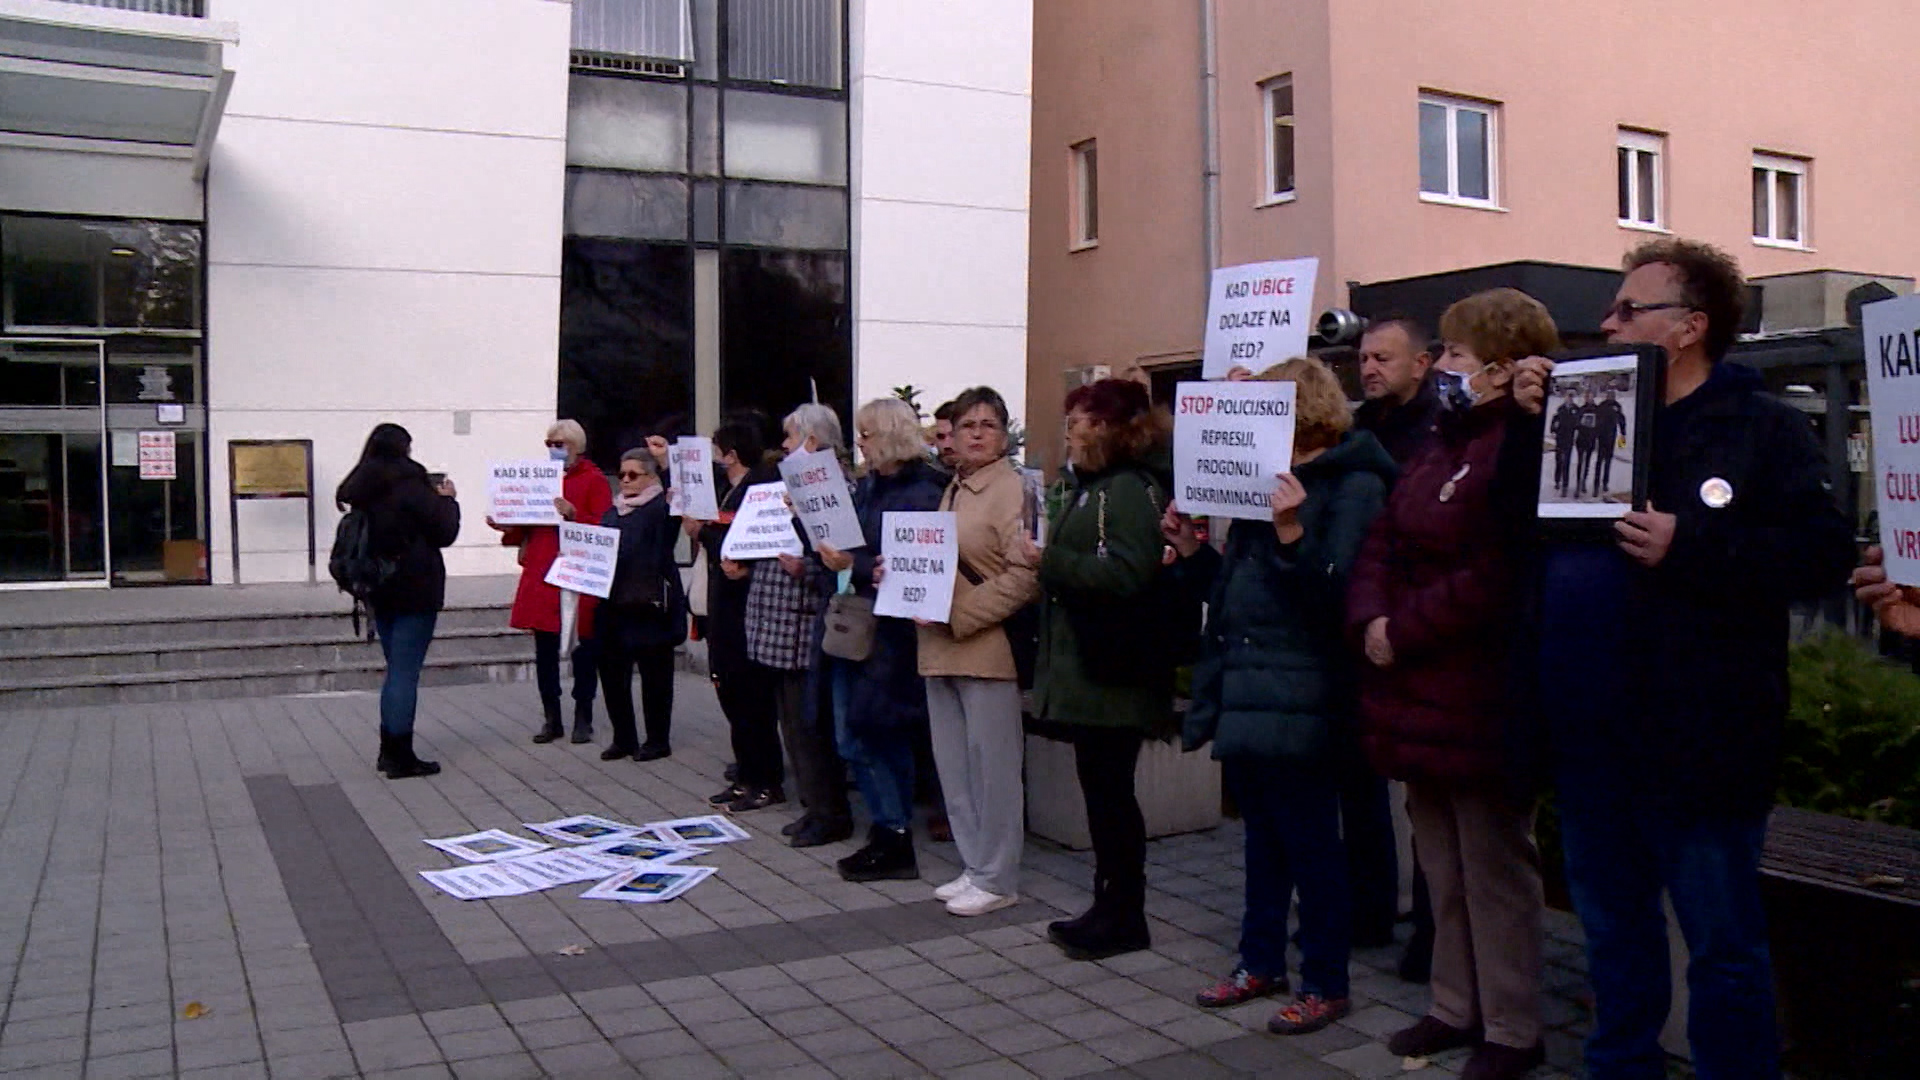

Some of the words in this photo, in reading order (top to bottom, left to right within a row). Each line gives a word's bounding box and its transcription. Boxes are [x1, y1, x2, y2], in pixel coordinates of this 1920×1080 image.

[1226, 281, 1249, 299] KAD
[1252, 277, 1295, 296] UBICE
[1219, 310, 1266, 330] DOLAZE
[1269, 309, 1291, 326] NA
[1230, 341, 1264, 359] RED?
[1181, 396, 1214, 414] STOP
[1217, 399, 1290, 416] POLICIJSKOJ
[1201, 429, 1256, 449] REPRESIJI,
[1197, 459, 1252, 477] PROGONU
[1255, 463, 1260, 477] I
[821, 493, 840, 508] NA
[895, 527, 915, 543] KAD
[917, 527, 945, 544] UBICE
[891, 557, 928, 574] DOLAZE
[929, 559, 945, 575] NA
[902, 587, 927, 603] RED?
